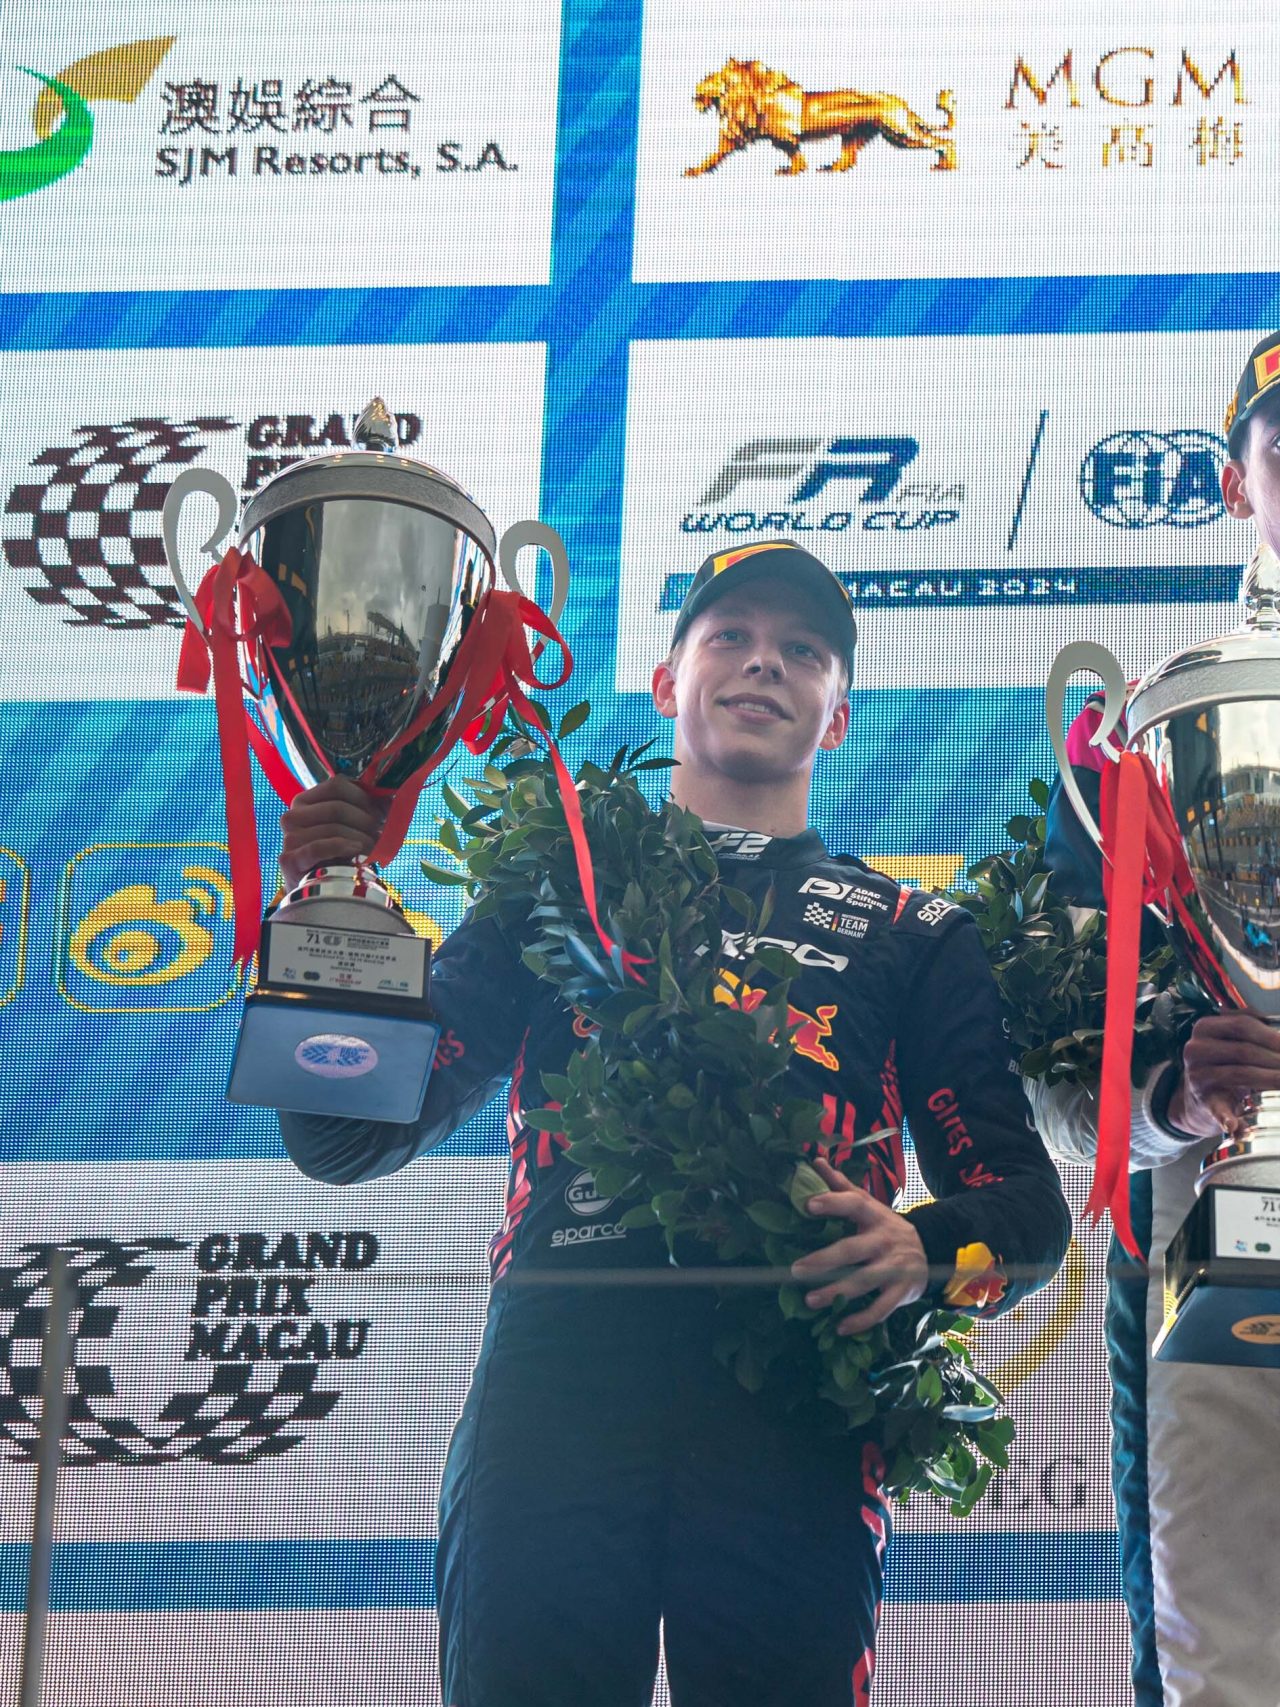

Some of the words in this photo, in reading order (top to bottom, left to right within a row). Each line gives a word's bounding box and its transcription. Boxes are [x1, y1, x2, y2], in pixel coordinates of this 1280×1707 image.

[1003, 47, 1254, 108] MGM
[159, 74, 420, 136] 澳娛綜合
[1016, 118, 1243, 169] 美高梅
[156, 147, 237, 184] SJM
[254, 145, 420, 178] Resorts,
[437, 142, 518, 173] S.A.
[246, 412, 423, 449] GRAD
[1093, 451, 1222, 505] FIA
[680, 512, 851, 532] WORLD
[863, 510, 959, 530] CUP
[979, 578, 1075, 596] 2024
[846, 898, 873, 910] Sport
[850, 892, 889, 911] Stiftung
[854, 887, 881, 899] ADAC
[836, 927, 866, 939] GERMANY
[840, 918, 869, 932] TEAM
[197, 1231, 381, 1271] GRAND
[552, 1223, 626, 1247] sparco
[193, 1278, 315, 1317] PRIX
[185, 1319, 372, 1361] MACAU
